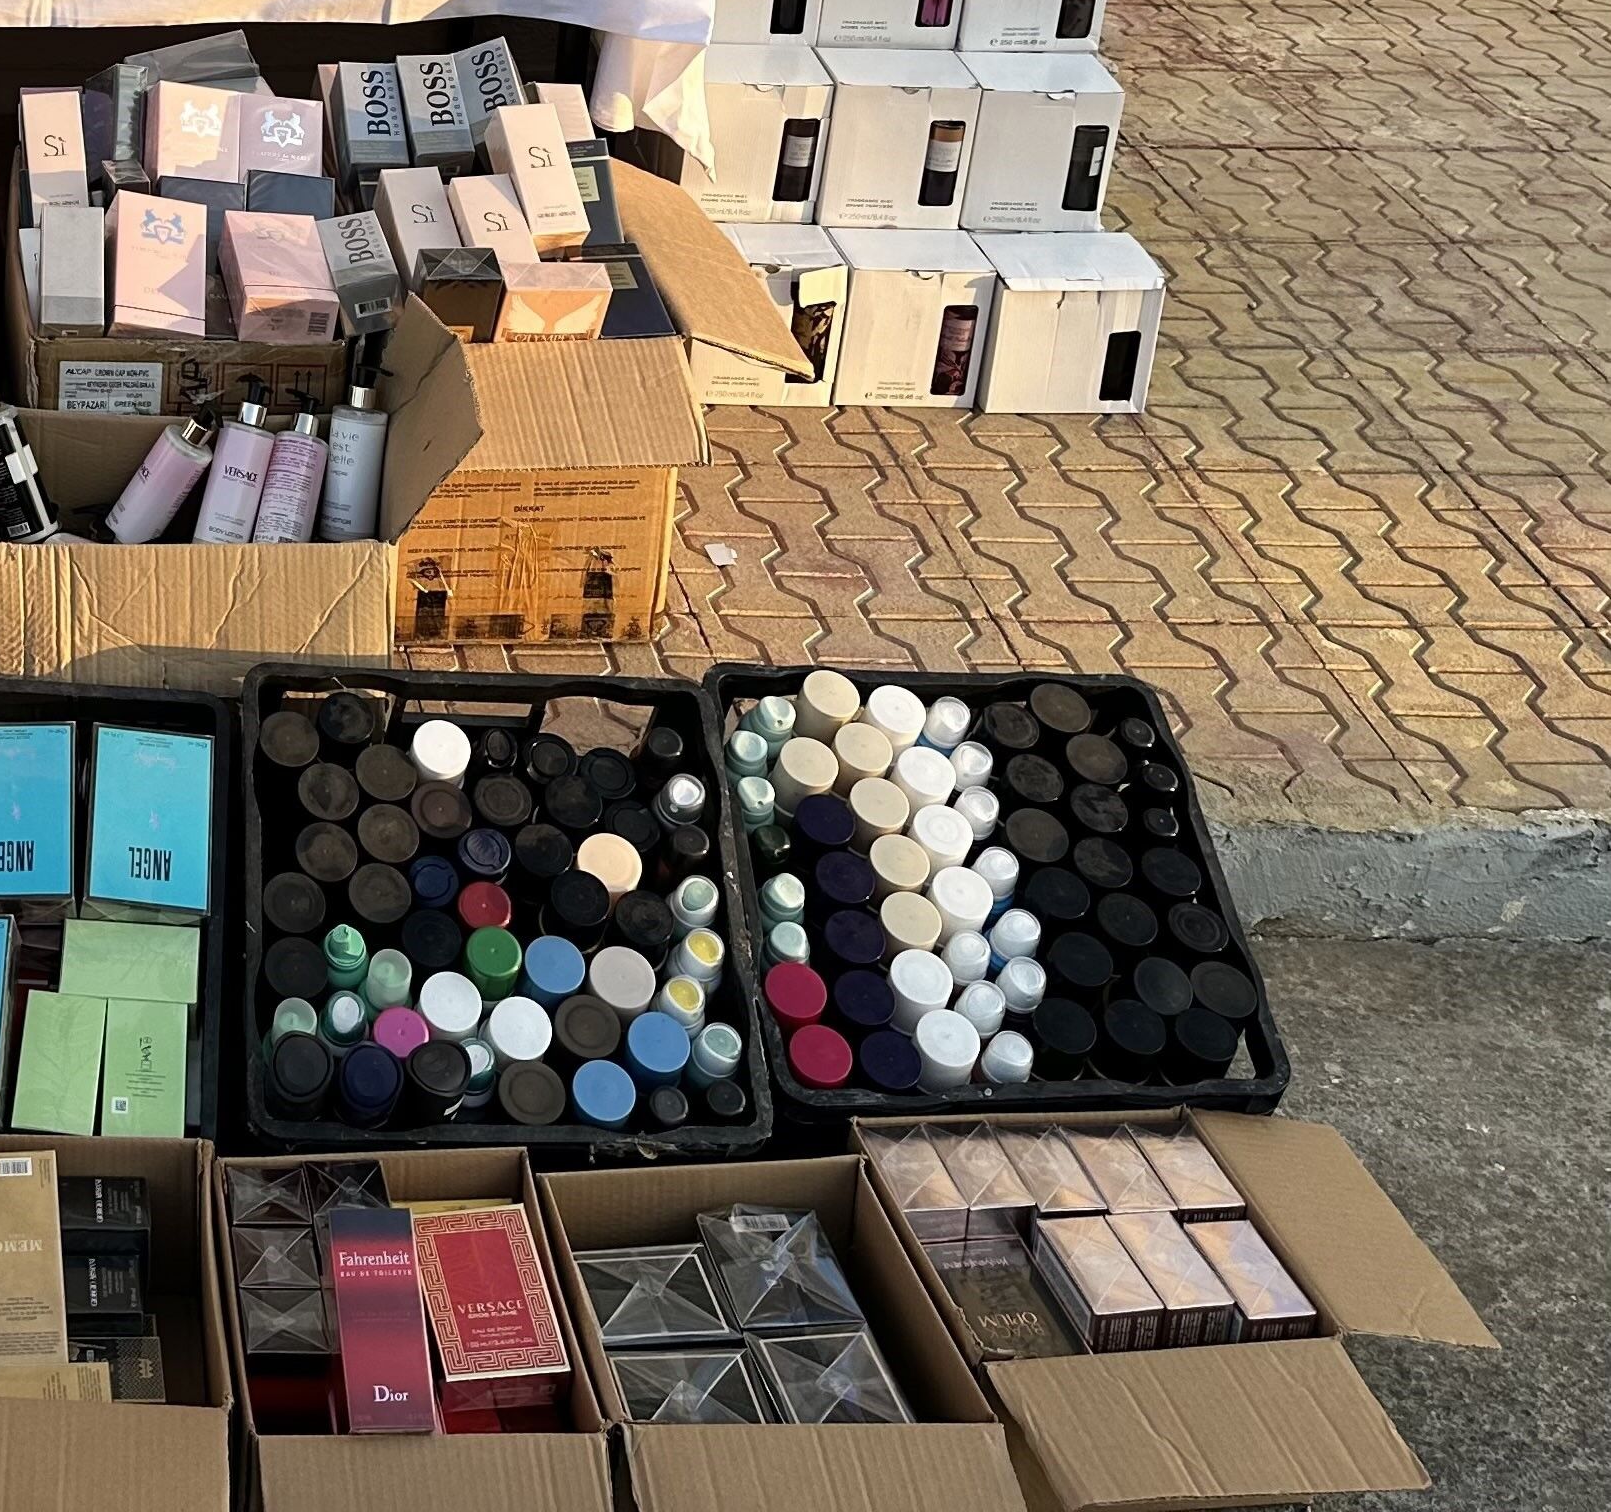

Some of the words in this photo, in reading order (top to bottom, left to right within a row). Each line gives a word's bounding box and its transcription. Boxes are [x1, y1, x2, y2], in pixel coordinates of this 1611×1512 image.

[471, 49, 508, 114] BOSS
[360, 70, 392, 137] BOSS
[419, 61, 456, 127] BOSS
[337, 216, 376, 266] BOSS
[332, 443, 351, 453] est
[223, 464, 259, 483] VERSACE
[128, 846, 173, 882] ANGEL
[339, 1250, 410, 1267] Fahrenheit
[457, 1299, 525, 1314] VERSACE
[977, 1311, 1038, 1328] OPIUM
[373, 1384, 409, 1403] Dior
